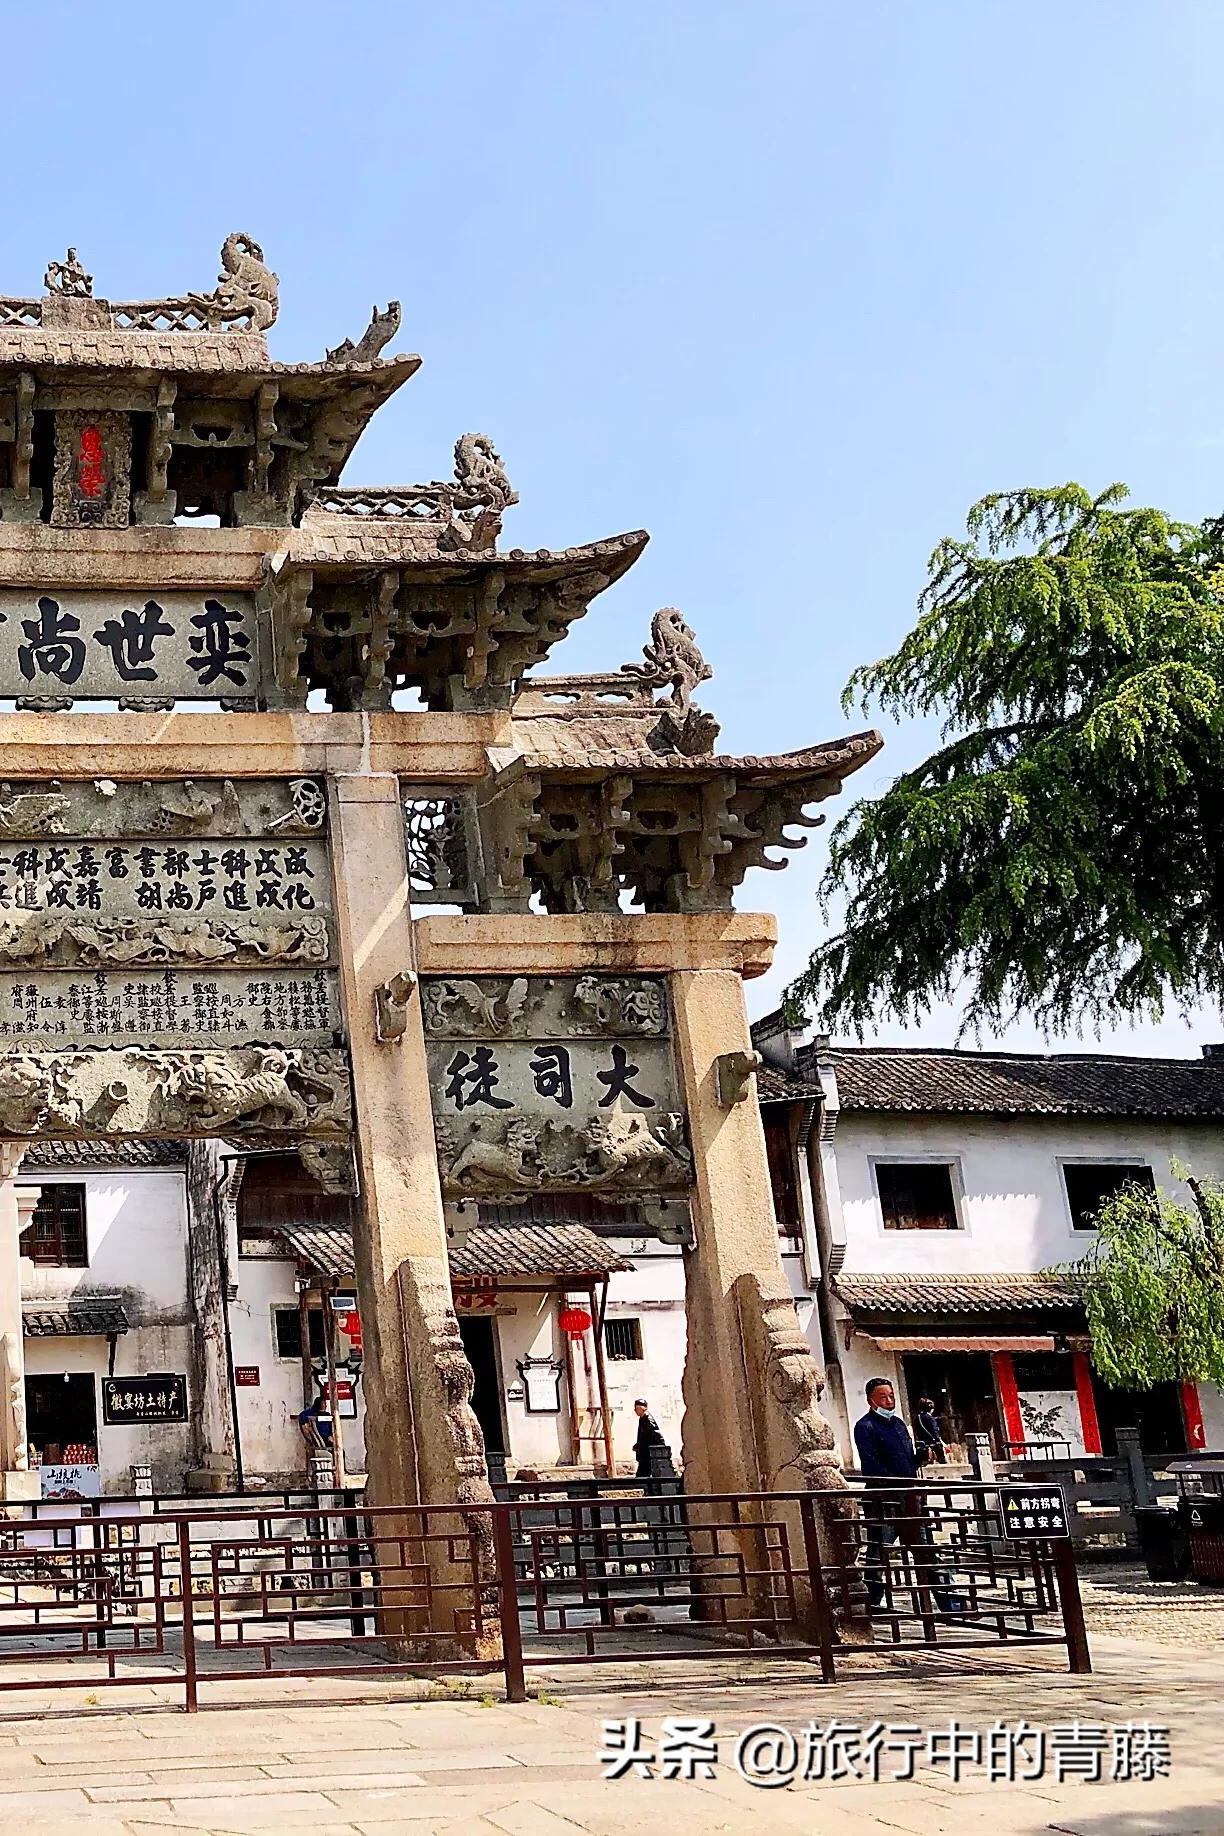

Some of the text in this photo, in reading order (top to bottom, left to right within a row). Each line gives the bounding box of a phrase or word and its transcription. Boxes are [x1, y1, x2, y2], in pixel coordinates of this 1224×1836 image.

[1020, 1497, 1060, 1510] 前方拐弯
[1010, 1516, 1063, 1528] 注意安全
